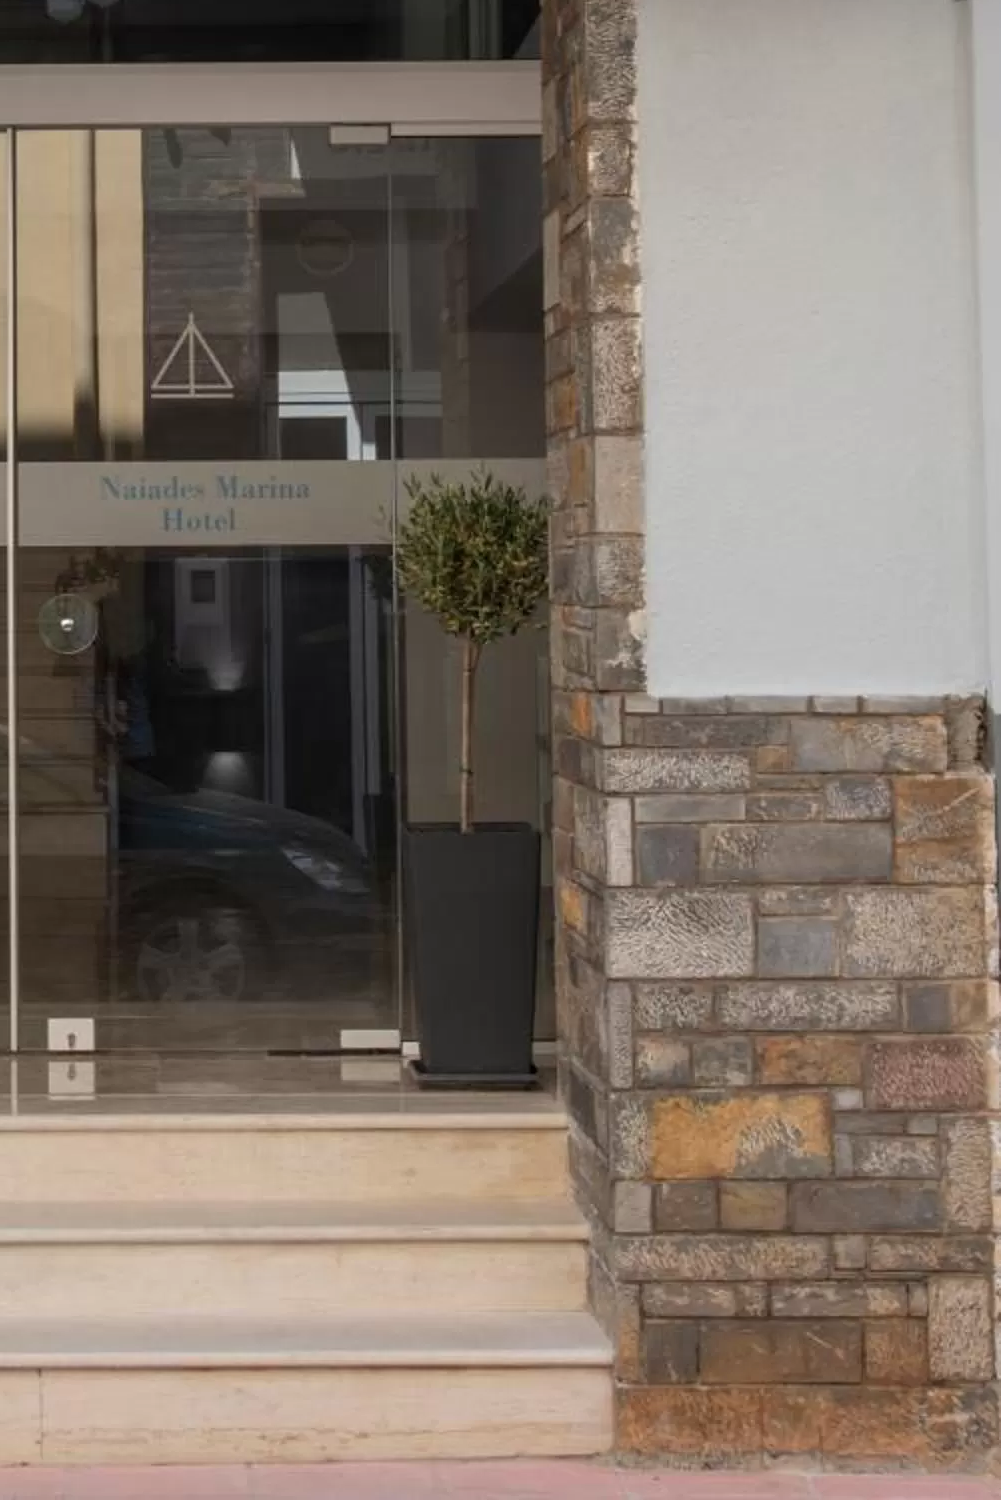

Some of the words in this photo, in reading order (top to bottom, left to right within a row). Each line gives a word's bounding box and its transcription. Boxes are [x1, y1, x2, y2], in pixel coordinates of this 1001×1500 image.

[102, 475, 204, 501] Naiades
[216, 475, 310, 500] Marina
[162, 507, 236, 532] Hotel
